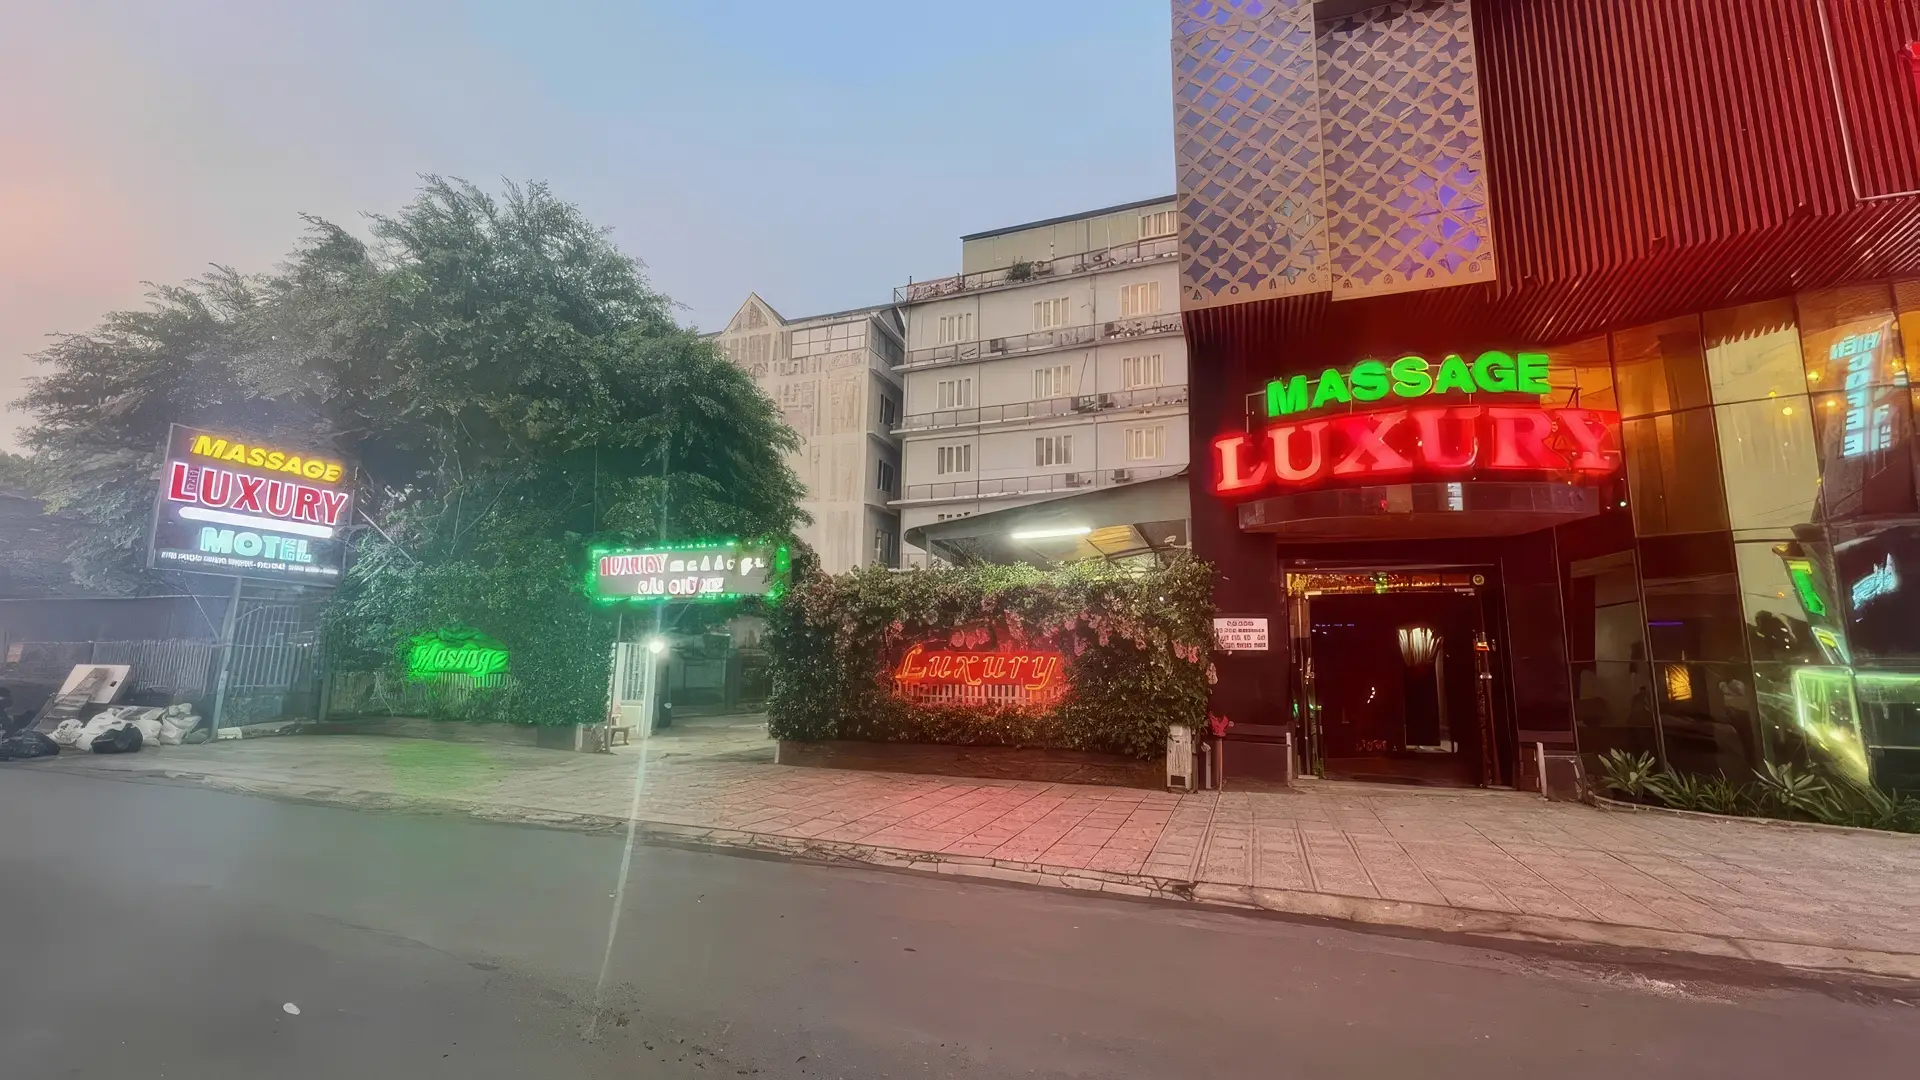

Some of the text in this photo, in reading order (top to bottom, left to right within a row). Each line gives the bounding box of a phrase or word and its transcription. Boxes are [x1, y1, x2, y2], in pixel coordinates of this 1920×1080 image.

[1266, 349, 1552, 418] MASSAGE
[191, 435, 344, 483] MASSAGE
[1213, 405, 1622, 494] LUXURY
[167, 461, 349, 526] LUXURY
[199, 526, 313, 564] MOTEL
[895, 643, 1058, 691] Luxury
